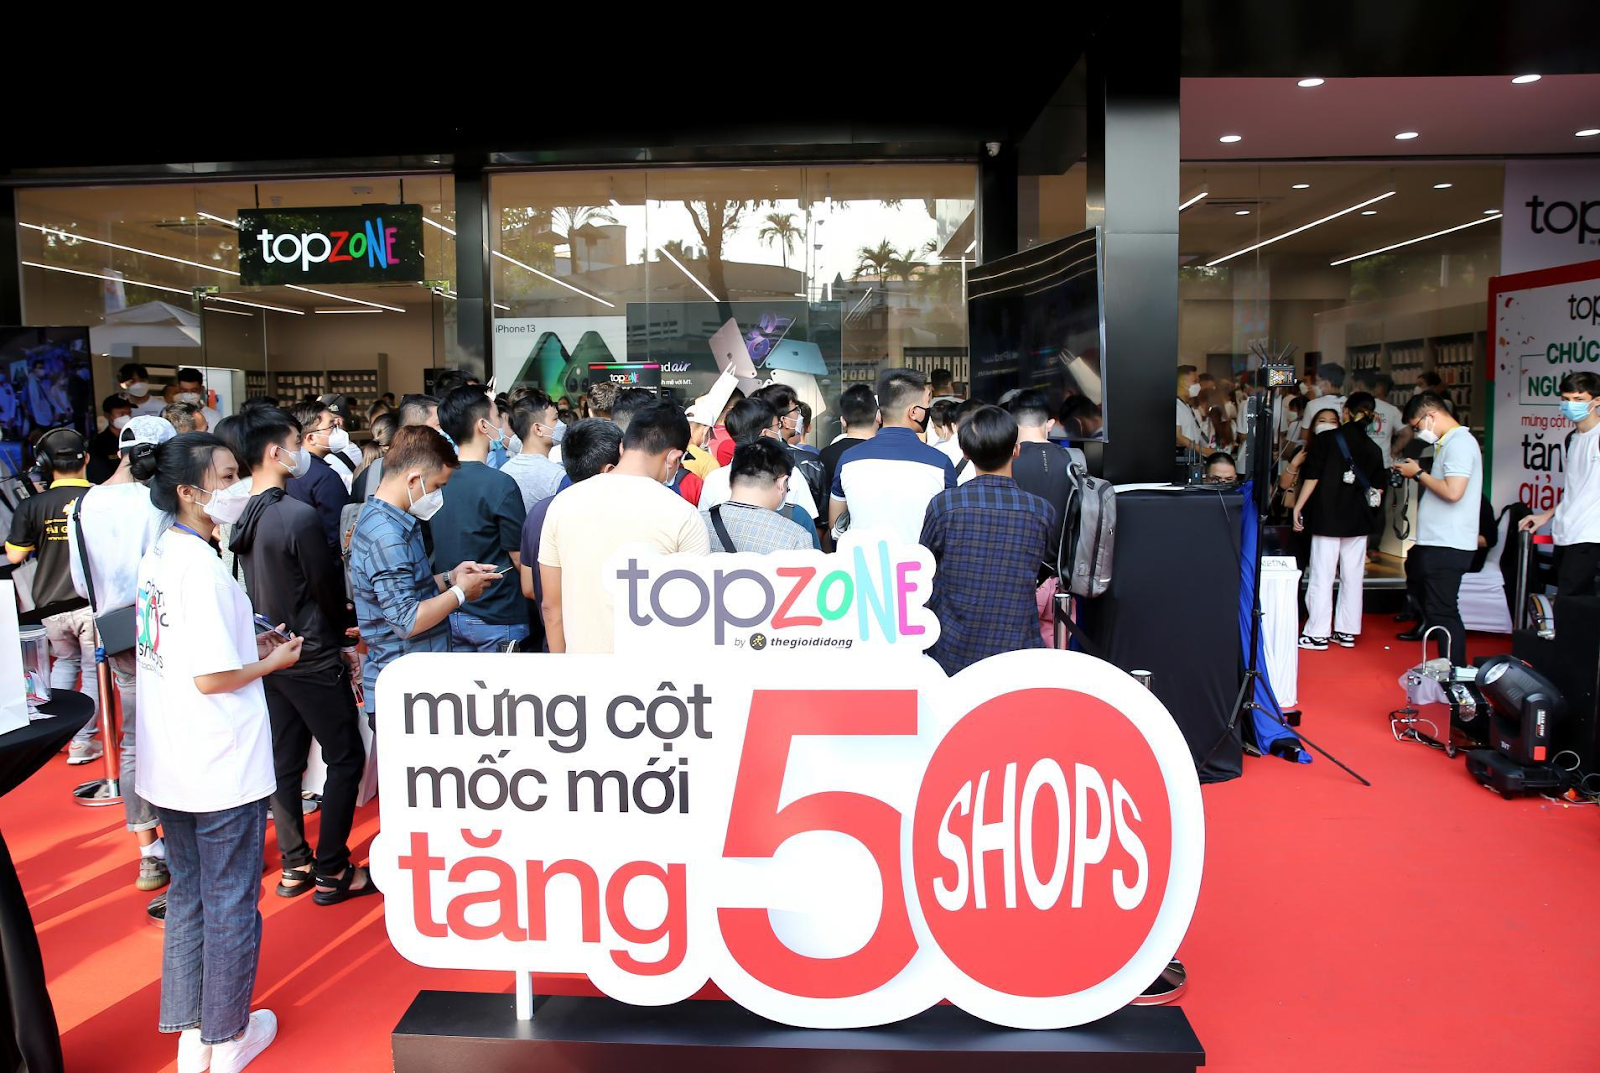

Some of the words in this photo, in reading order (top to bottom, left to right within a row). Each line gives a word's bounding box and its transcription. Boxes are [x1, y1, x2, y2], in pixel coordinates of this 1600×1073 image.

[495, 324, 526, 333] iPhone
[526, 324, 536, 333] 13
[671, 360, 692, 372] air
[1546, 335, 1600, 365] CHÚC
[1521, 433, 1563, 472] tăn
[1519, 474, 1564, 511] giả
[734, 638, 746, 649] by
[770, 637, 853, 649] thegioididong
[404, 680, 587, 753] mừng
[606, 681, 712, 752] cột
[406, 749, 547, 811] mốc
[567, 757, 689, 814] mới
[933, 757, 1149, 912] SHOPS
[398, 828, 688, 976] tăng
